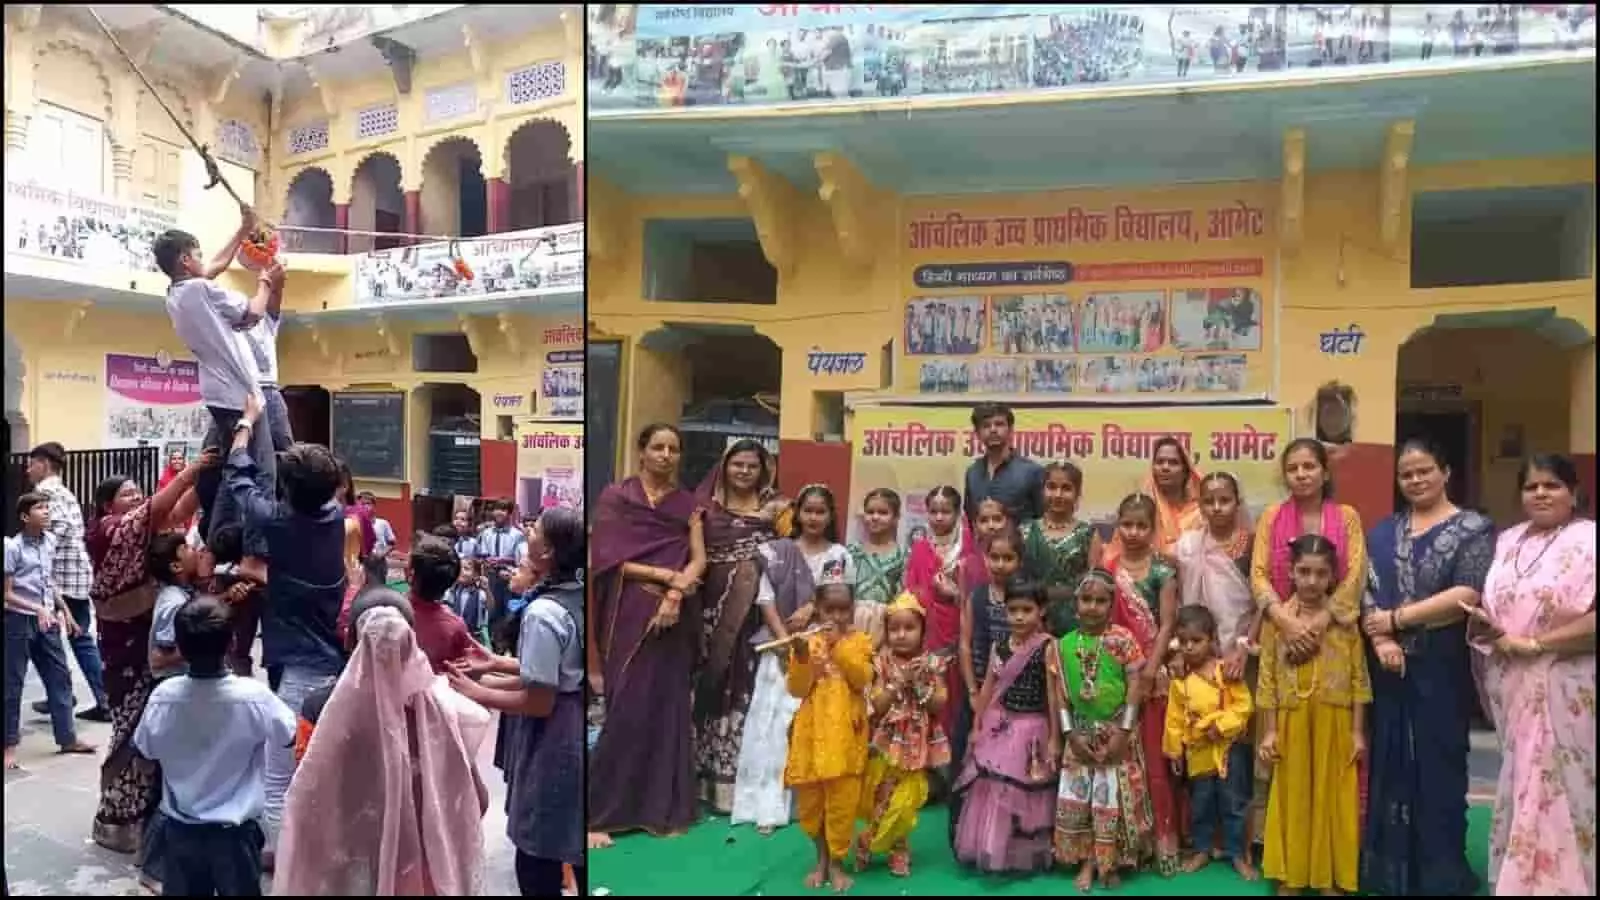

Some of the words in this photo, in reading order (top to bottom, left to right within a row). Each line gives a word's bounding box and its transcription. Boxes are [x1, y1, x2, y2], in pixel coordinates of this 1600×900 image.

[909, 212, 988, 249] आंचलिक
[994, 217, 1027, 247] उच्च
[1032, 206, 1108, 247] प्राथमिक
[1207, 199, 1264, 239] आमेट
[1320, 323, 1365, 355] घंटी
[807, 344, 867, 376] पेयजल
[863, 421, 957, 458] आंचलिक
[1210, 424, 1278, 461] आमेट
